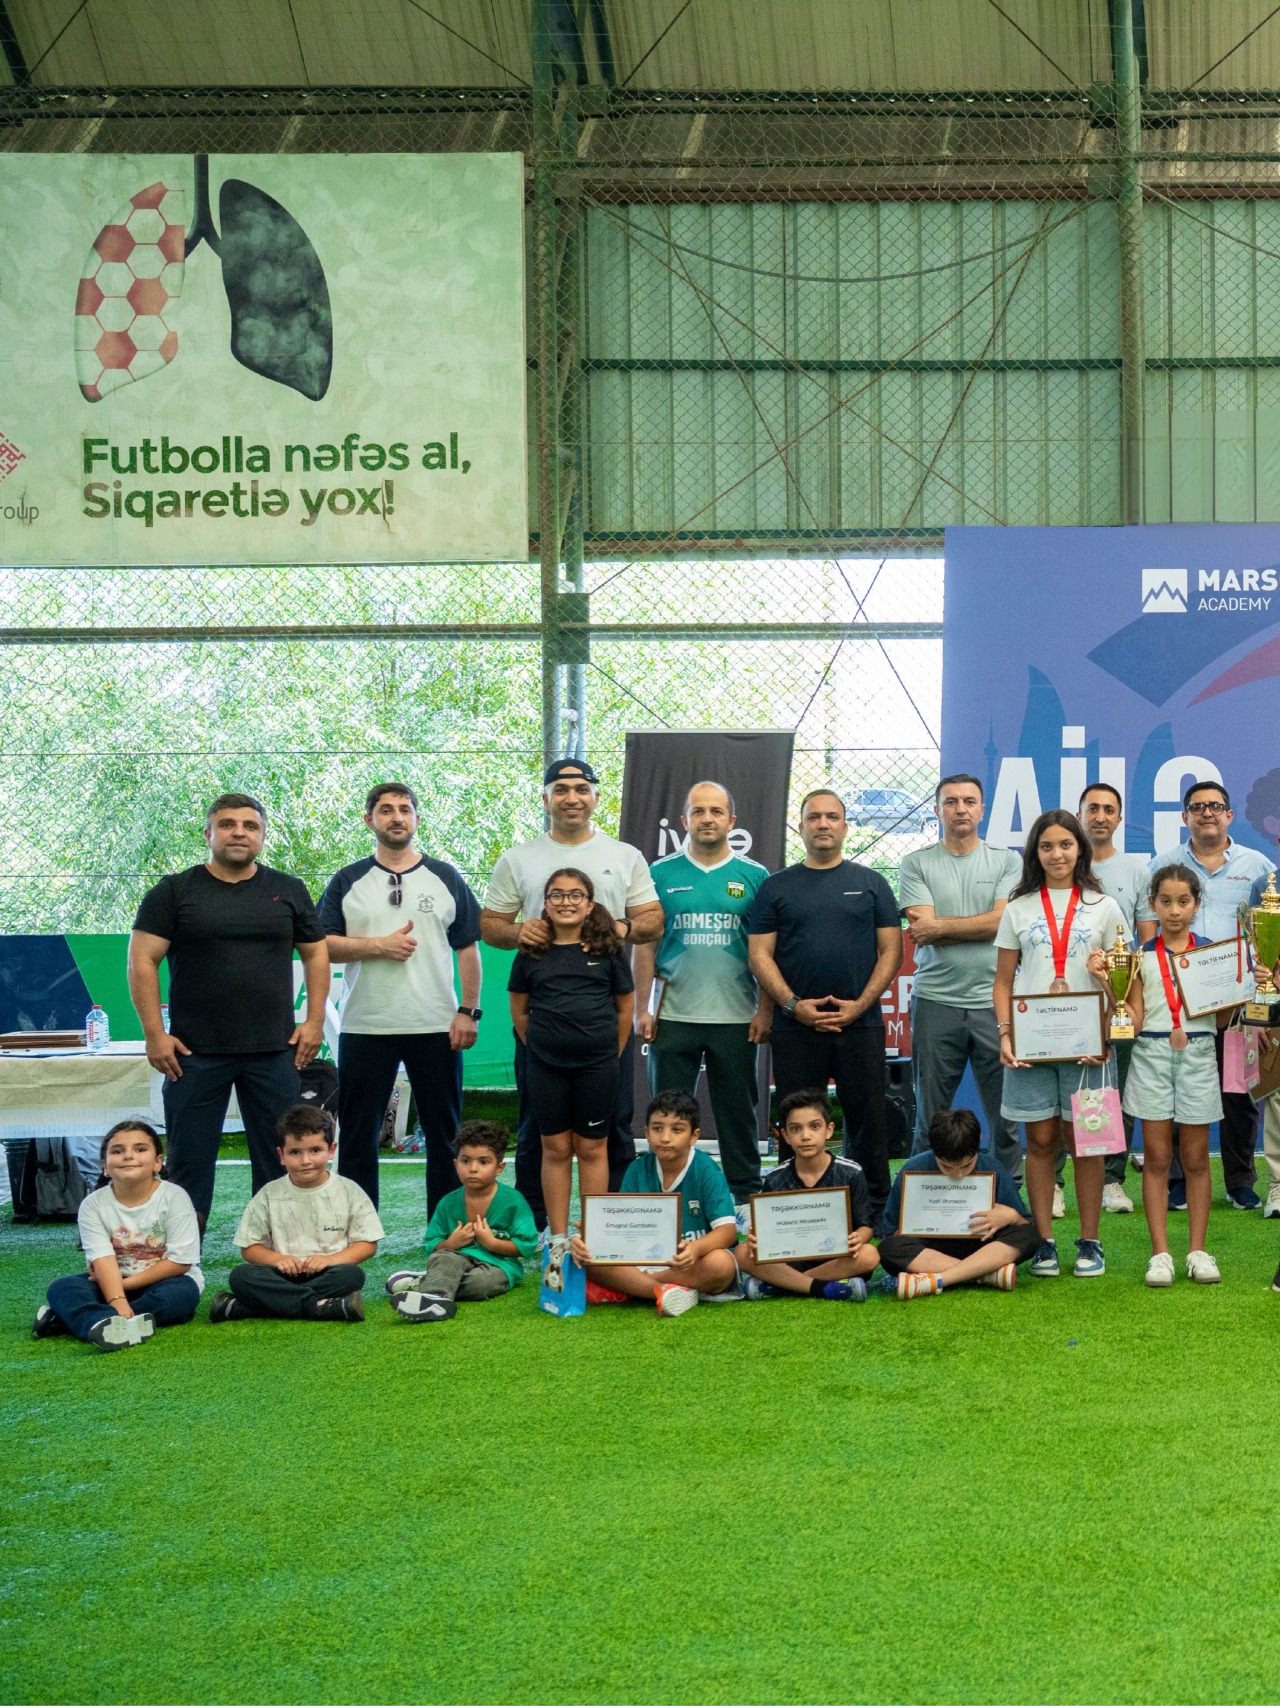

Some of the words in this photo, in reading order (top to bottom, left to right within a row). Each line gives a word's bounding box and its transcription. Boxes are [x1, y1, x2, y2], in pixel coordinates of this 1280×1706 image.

[83, 436, 270, 474] Futbolla
[284, 433, 410, 472] nəfəs
[421, 431, 472, 475] al,
[0, 505, 39, 524] oup
[83, 479, 290, 528] Siqaretlə
[299, 479, 395, 527] yox!
[1198, 597, 1272, 612] ACADEMY
[658, 818, 753, 856] ivə
